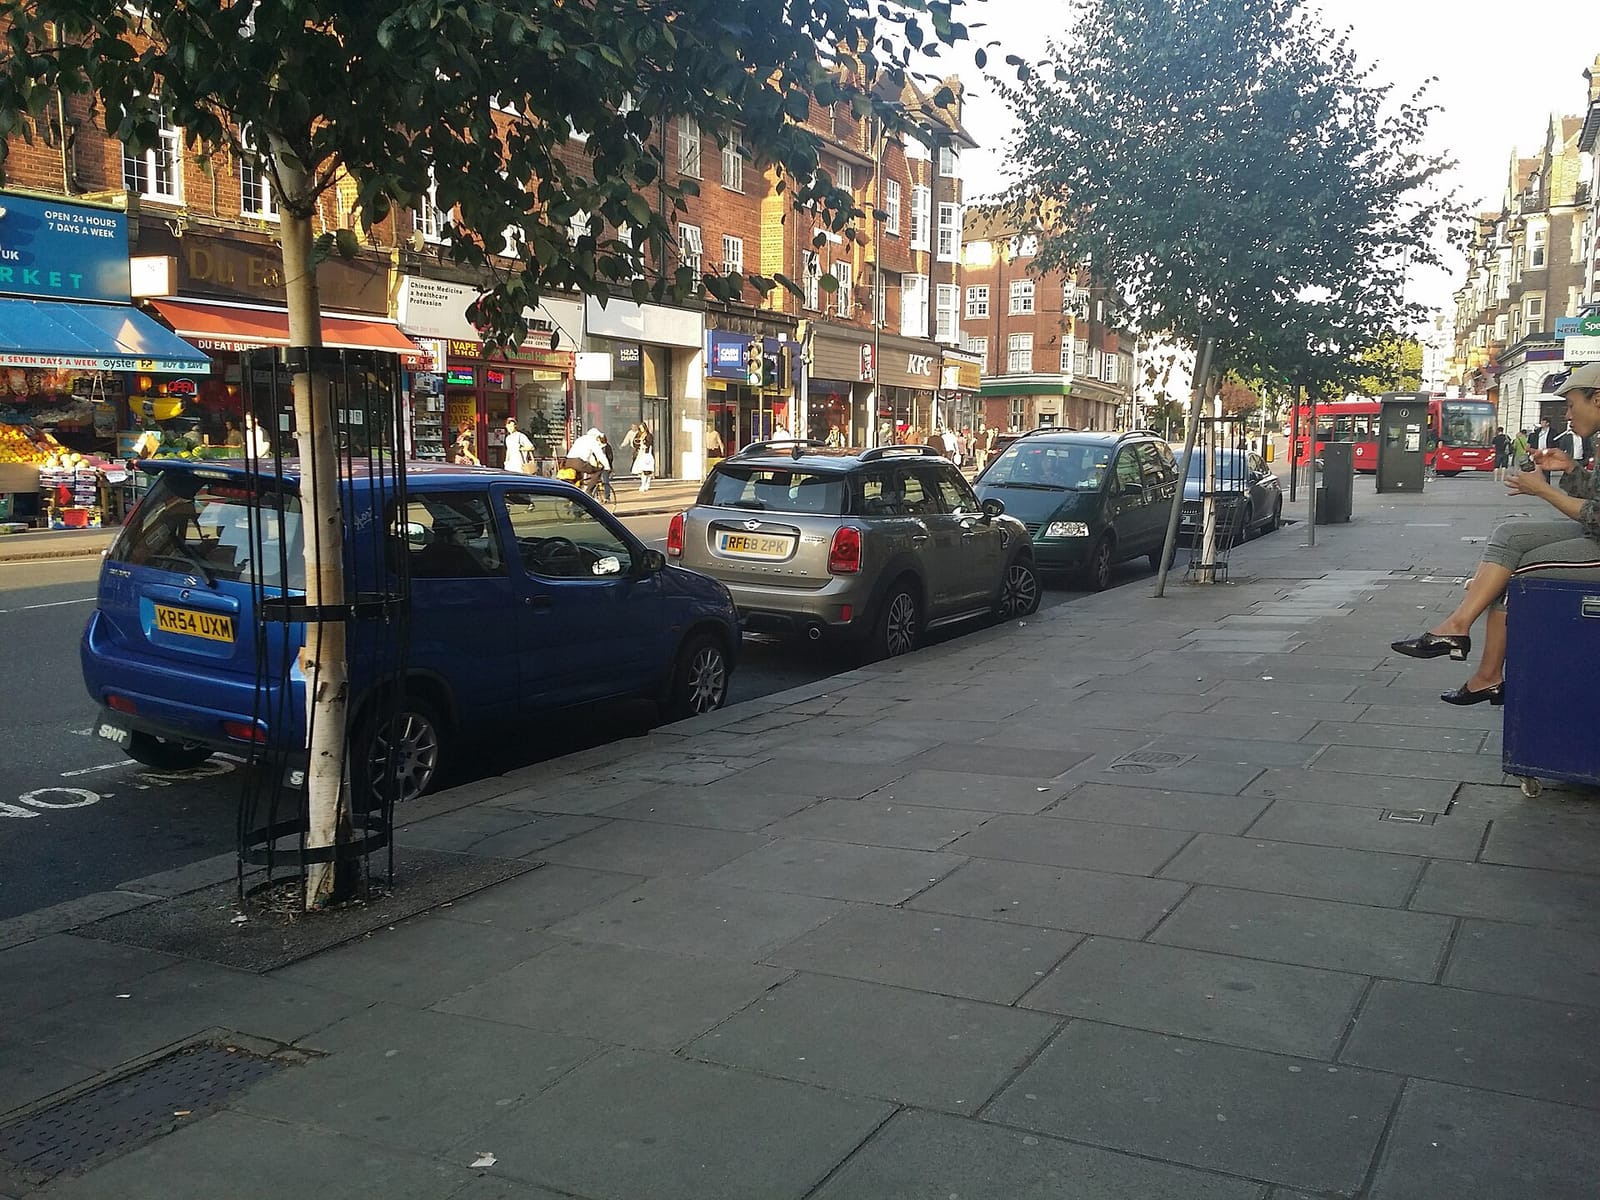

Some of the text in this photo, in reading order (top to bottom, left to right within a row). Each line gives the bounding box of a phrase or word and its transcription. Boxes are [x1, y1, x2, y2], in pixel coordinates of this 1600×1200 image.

[44, 210, 117, 228] OPEN 24 HOURS
[48, 222, 115, 238] 7 DAYS A WEEK
[410, 281, 463, 295] Chinese Medicine
[415, 290, 449, 300] healthcare
[409, 297, 442, 306] Profession
[198, 340, 212, 350] DU
[214, 341, 231, 351] EAT
[453, 341, 476, 352] VAPE
[7, 355, 37, 364] SEVEN
[40, 356, 63, 365] DAYS
[74, 359, 98, 367] WEEK
[407, 356, 417, 364] 22
[906, 353, 933, 376] KFC
[728, 536, 784, 553] RF68 ZPK
[157, 608, 231, 638] KR54 UXM
[99, 723, 128, 744] SWT
